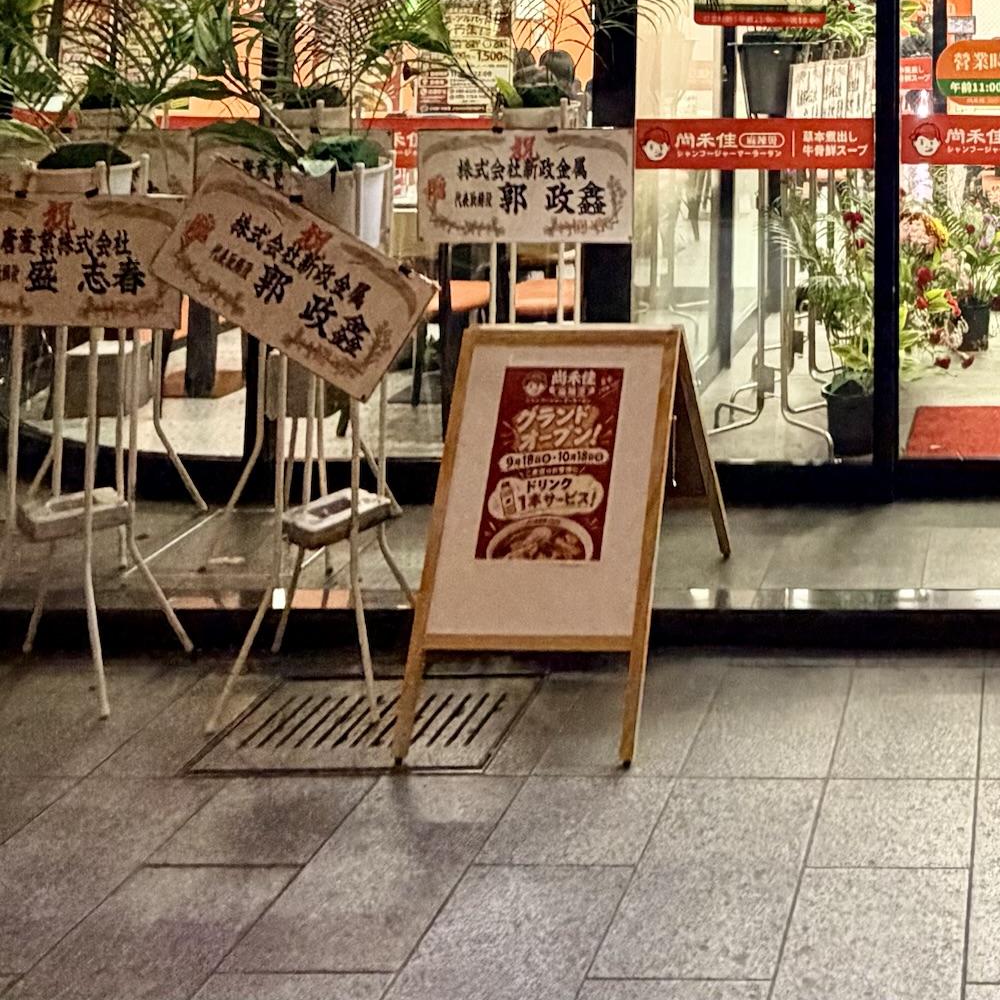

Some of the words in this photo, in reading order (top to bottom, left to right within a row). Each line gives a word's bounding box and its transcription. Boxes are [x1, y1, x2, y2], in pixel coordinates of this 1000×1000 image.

[498, 181, 528, 216] 郭
[516, 404, 591, 434] グランド
[527, 478, 572, 494] ドリンク
